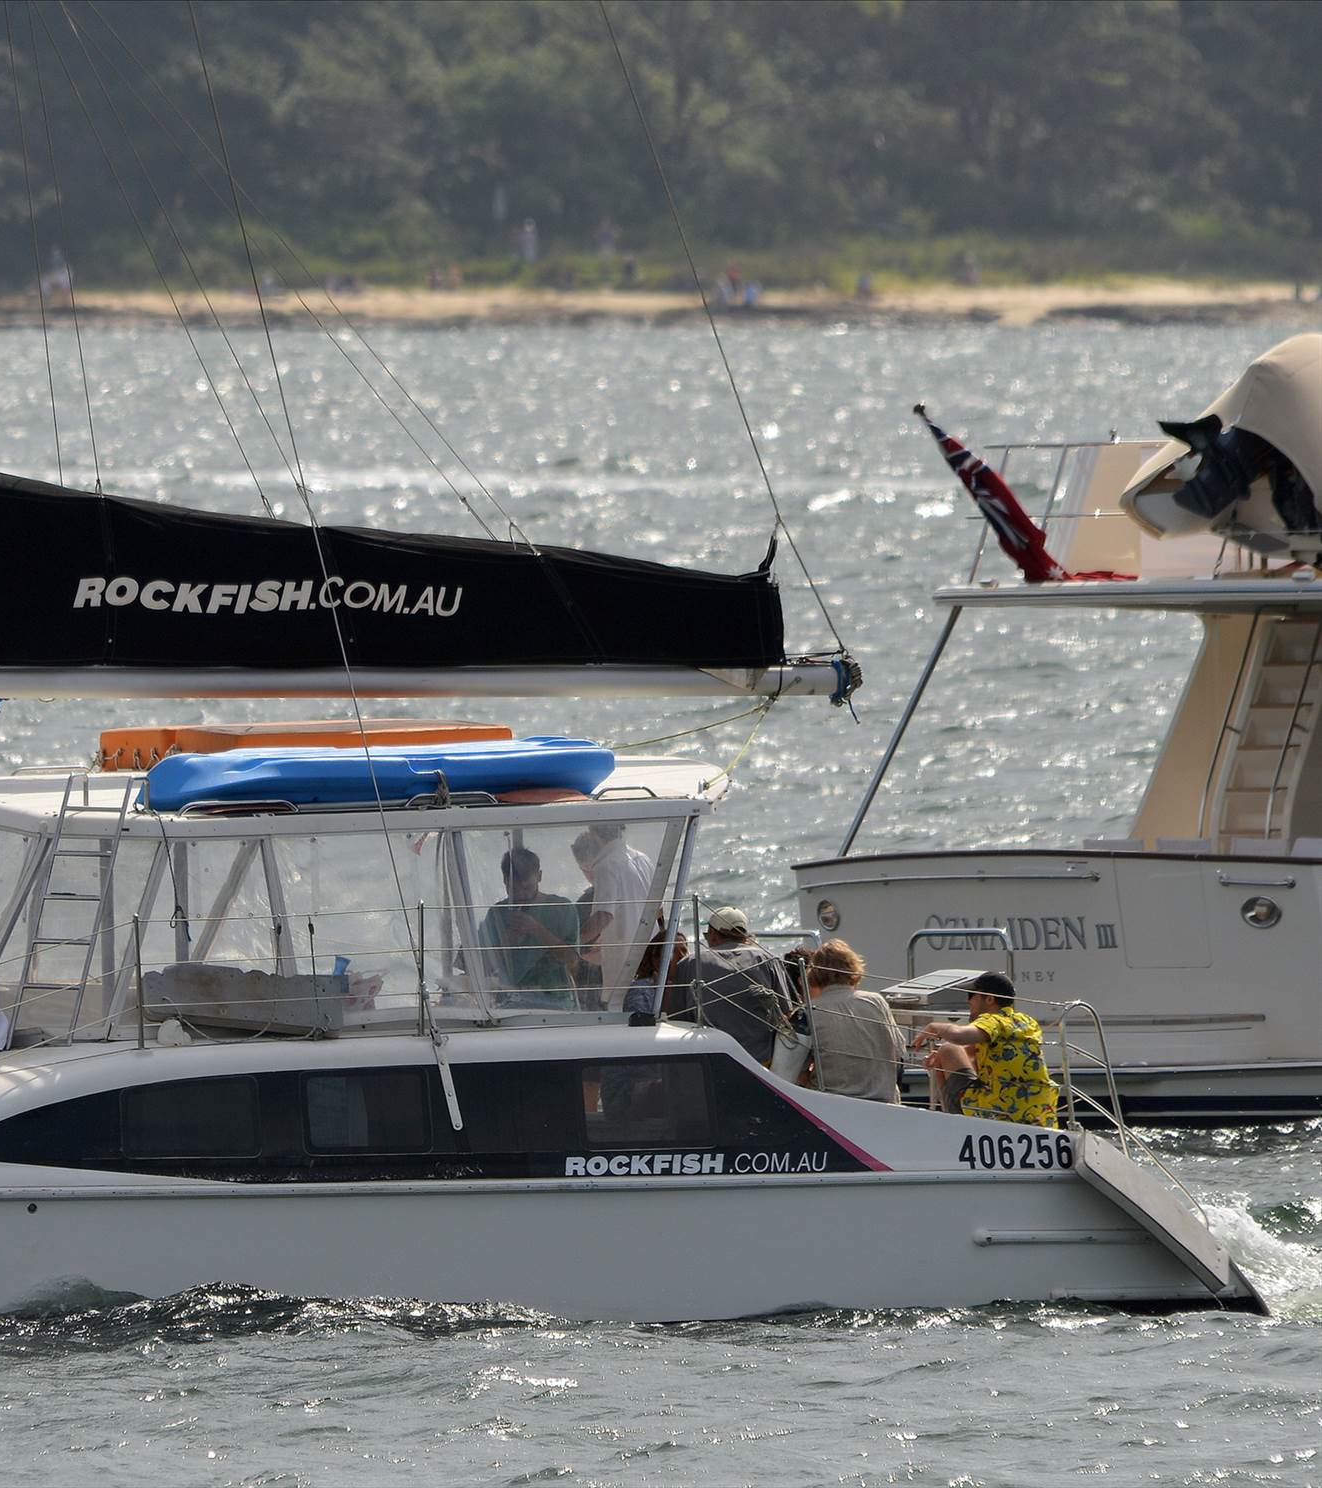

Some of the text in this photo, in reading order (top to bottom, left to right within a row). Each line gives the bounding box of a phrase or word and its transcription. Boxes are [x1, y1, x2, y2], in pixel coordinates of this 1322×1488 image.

[72, 575, 463, 617] ROCKFISH.COM.AU
[924, 913, 1119, 951] OZMAIDEN III
[1013, 970, 1055, 982] NEY
[564, 1151, 828, 1177] ROCKFISH.COM.AU
[958, 1133, 1074, 1170] 406256
